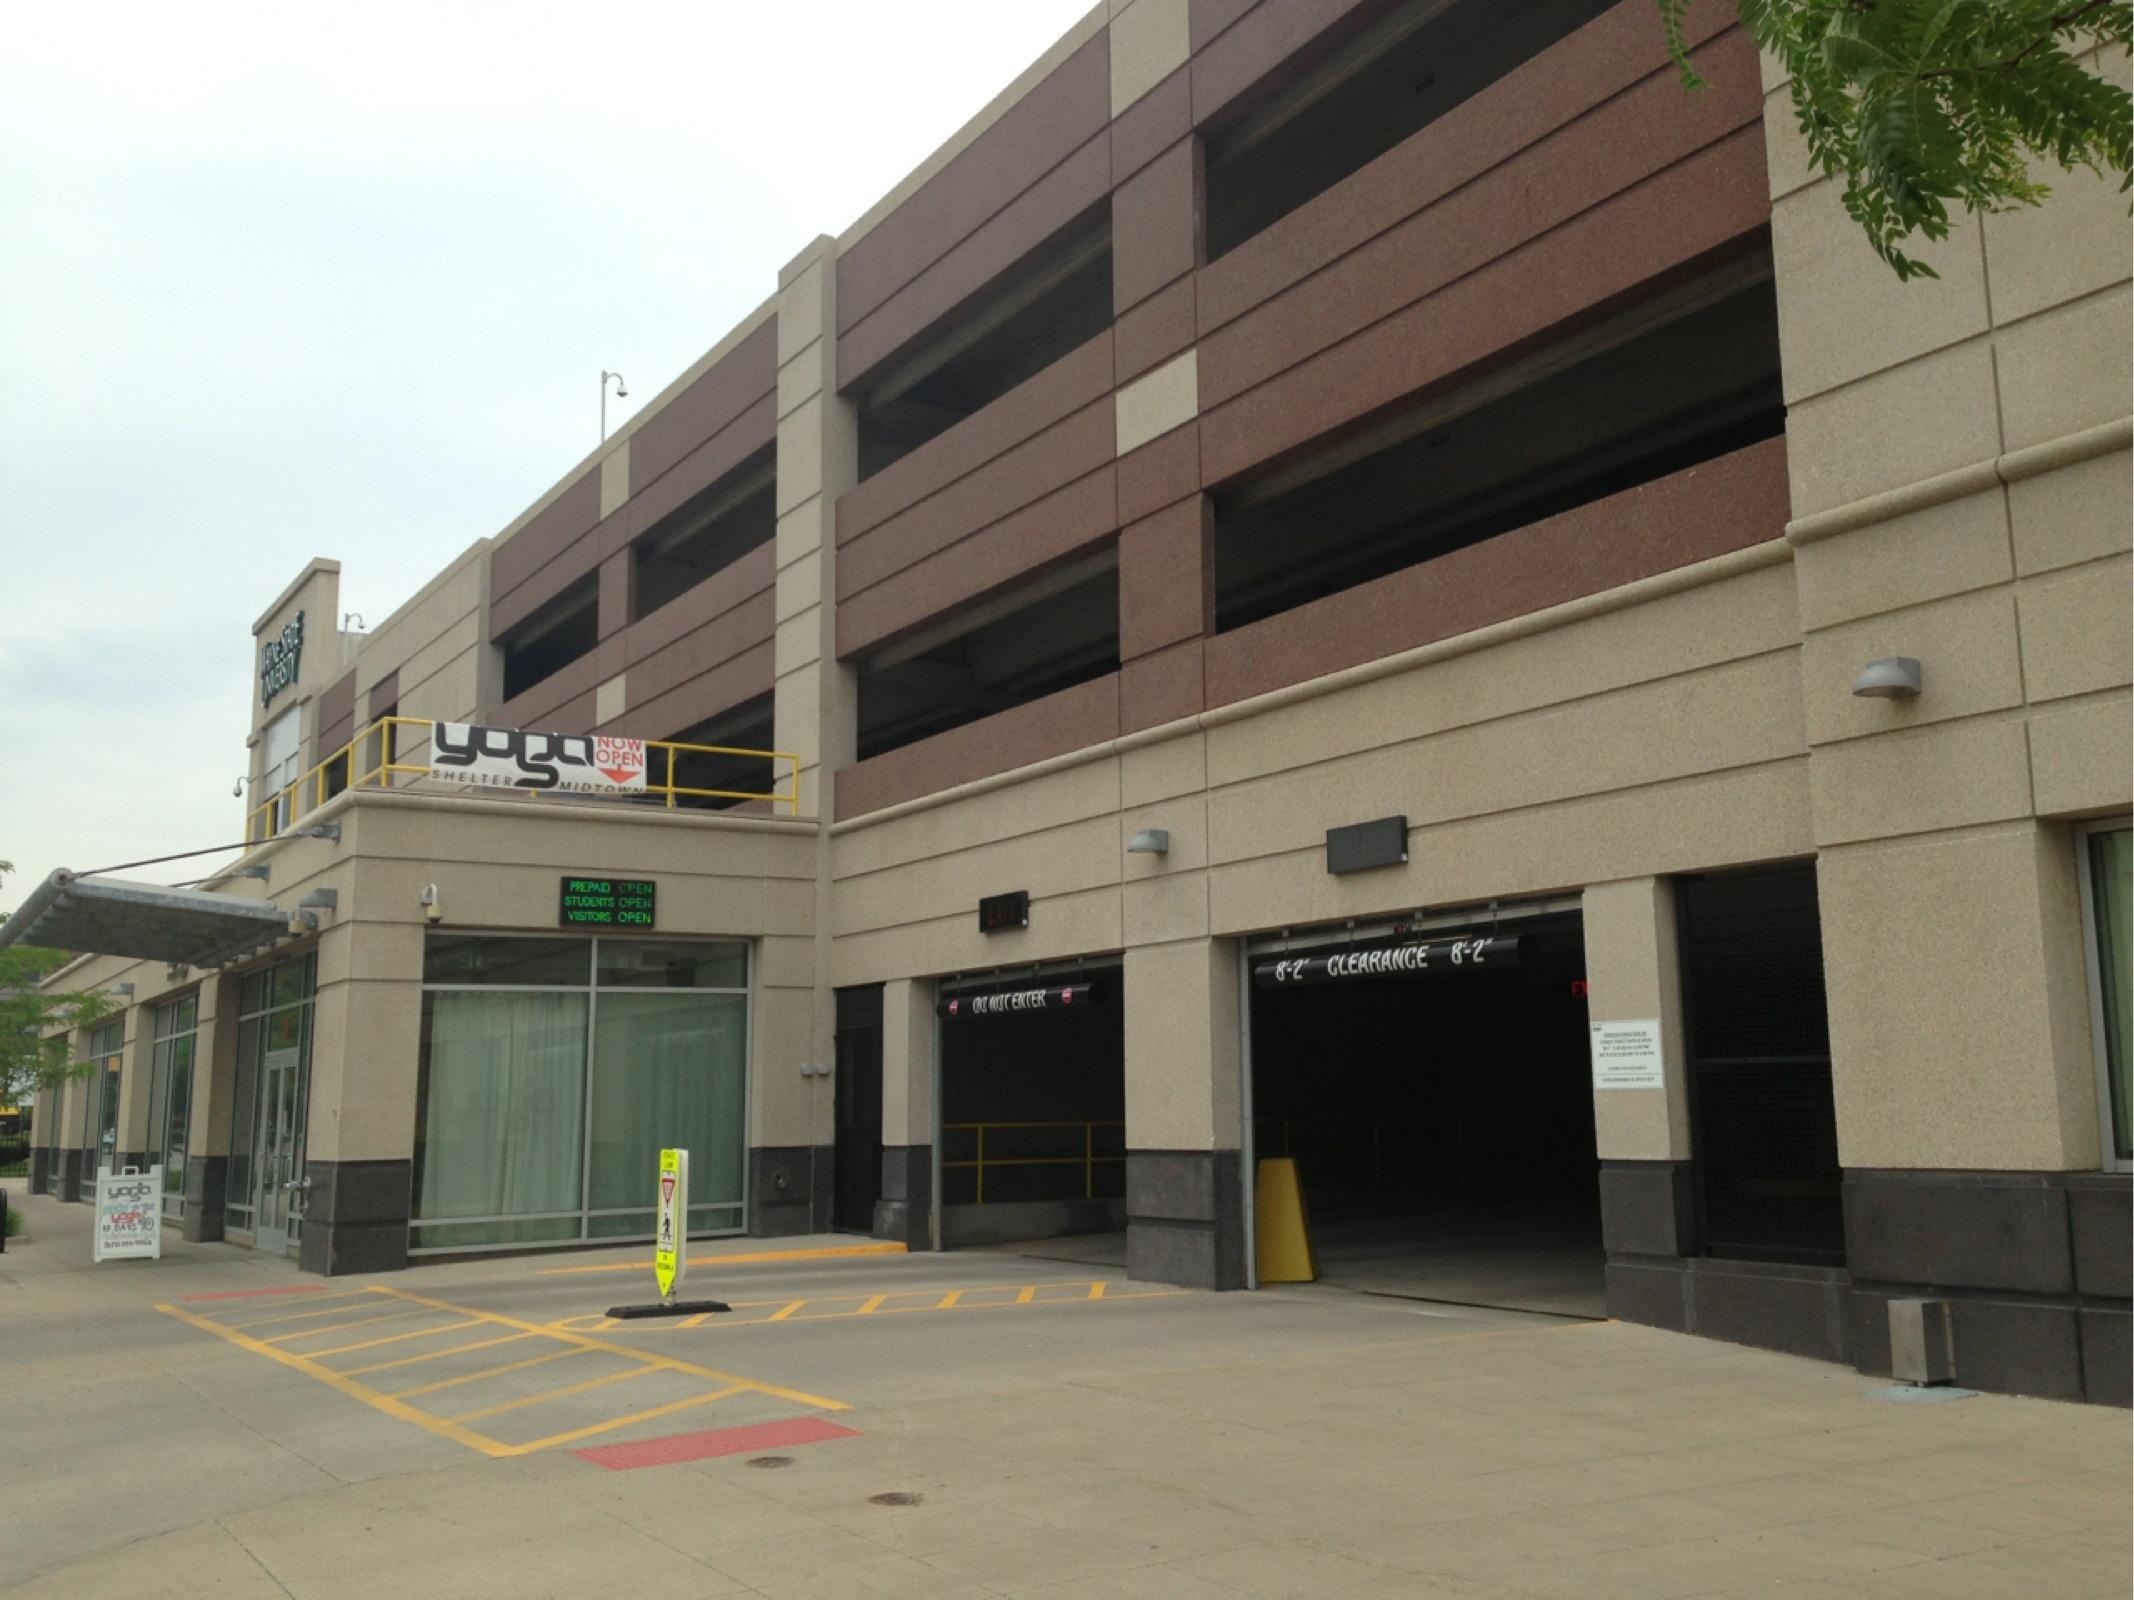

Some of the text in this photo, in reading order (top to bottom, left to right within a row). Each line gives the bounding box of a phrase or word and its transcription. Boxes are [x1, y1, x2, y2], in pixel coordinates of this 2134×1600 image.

[597, 737, 641, 751] NOW
[596, 751, 643, 767] OPEN
[432, 769, 513, 786] SHELTER
[569, 881, 653, 894] PREPAID OPEN
[564, 896, 652, 909] STUDENTS OPEN
[567, 911, 651, 924] VISITORS OPEN
[1327, 945, 1429, 977] CLEARANCE
[989, 993, 1011, 1012] NOT
[1011, 989, 1047, 1010] ENTER
